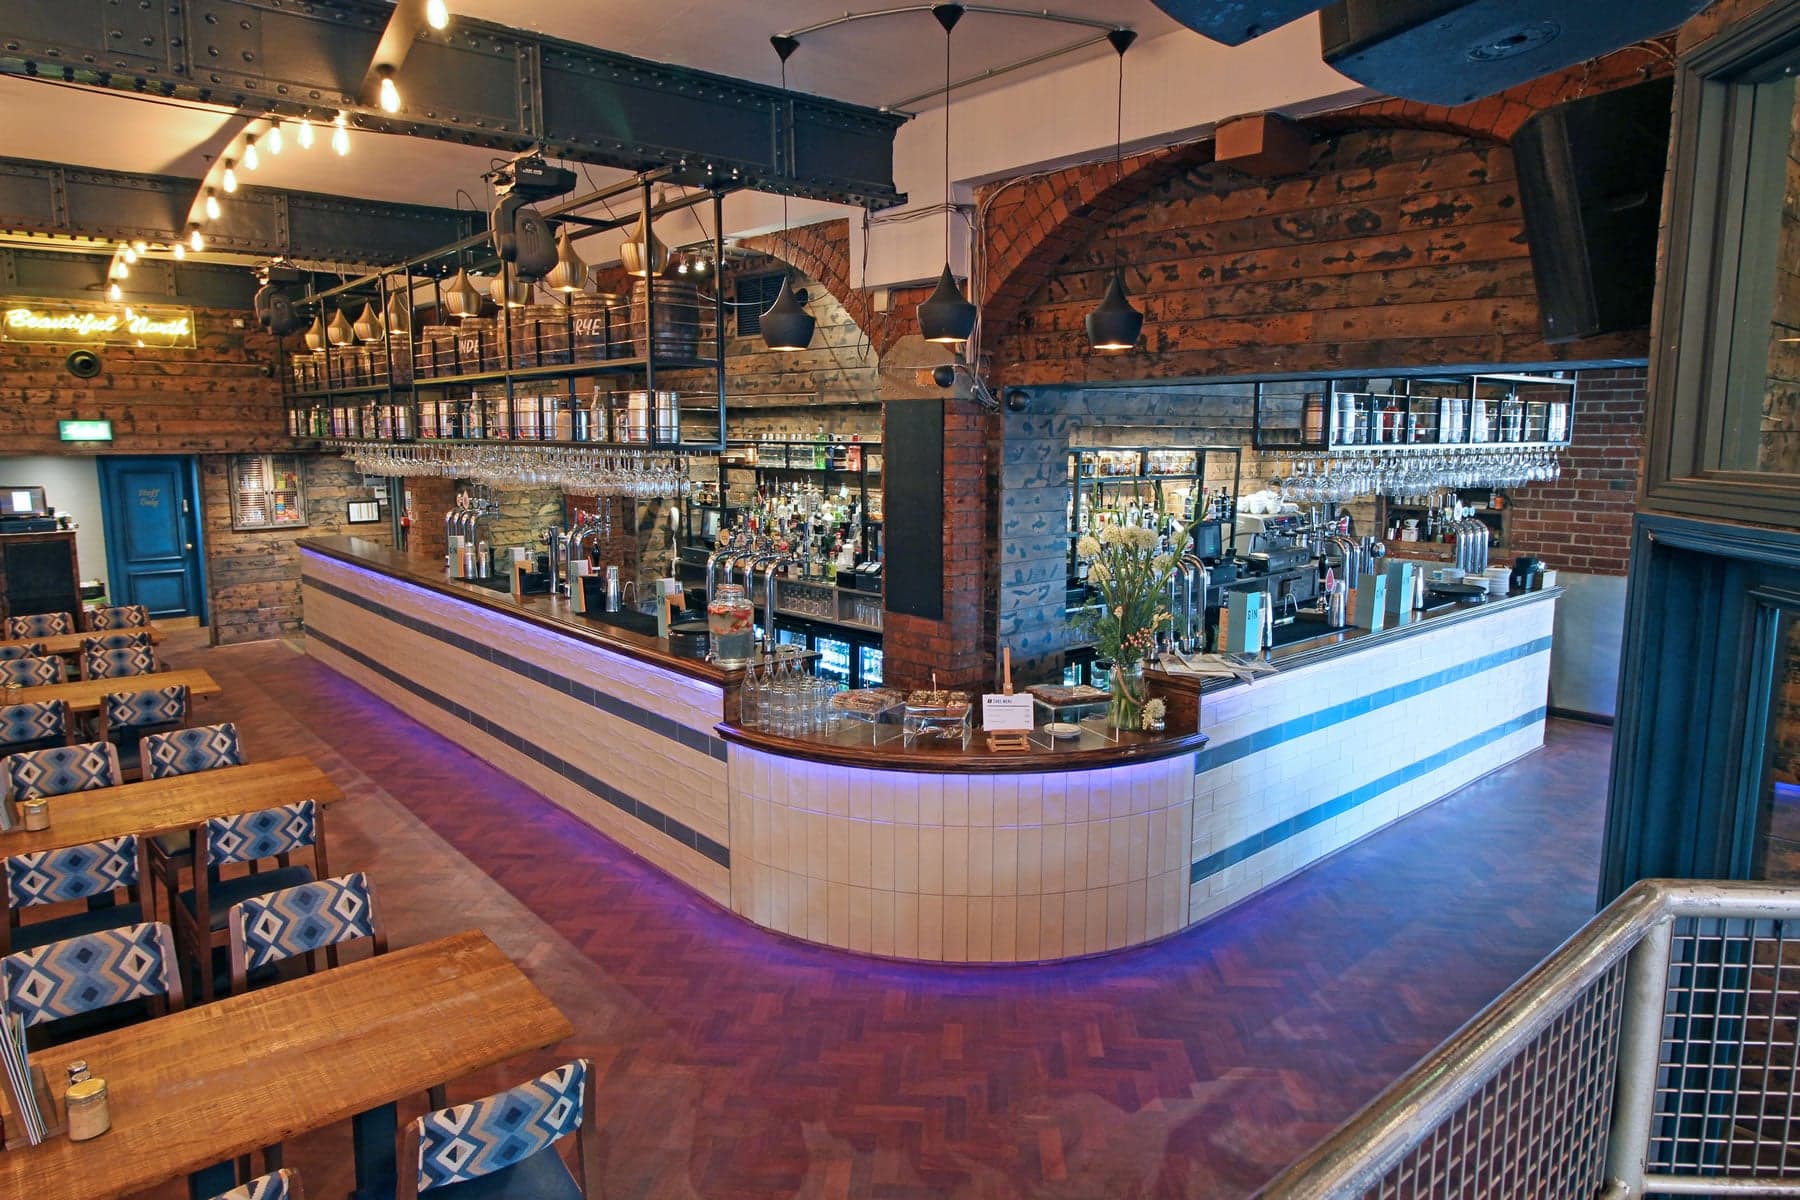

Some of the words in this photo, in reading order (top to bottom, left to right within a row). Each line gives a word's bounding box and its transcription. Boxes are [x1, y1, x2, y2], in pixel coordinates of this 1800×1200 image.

[6, 309, 118, 335] Beautiful
[127, 311, 191, 336] North
[575, 318, 601, 336] RYE
